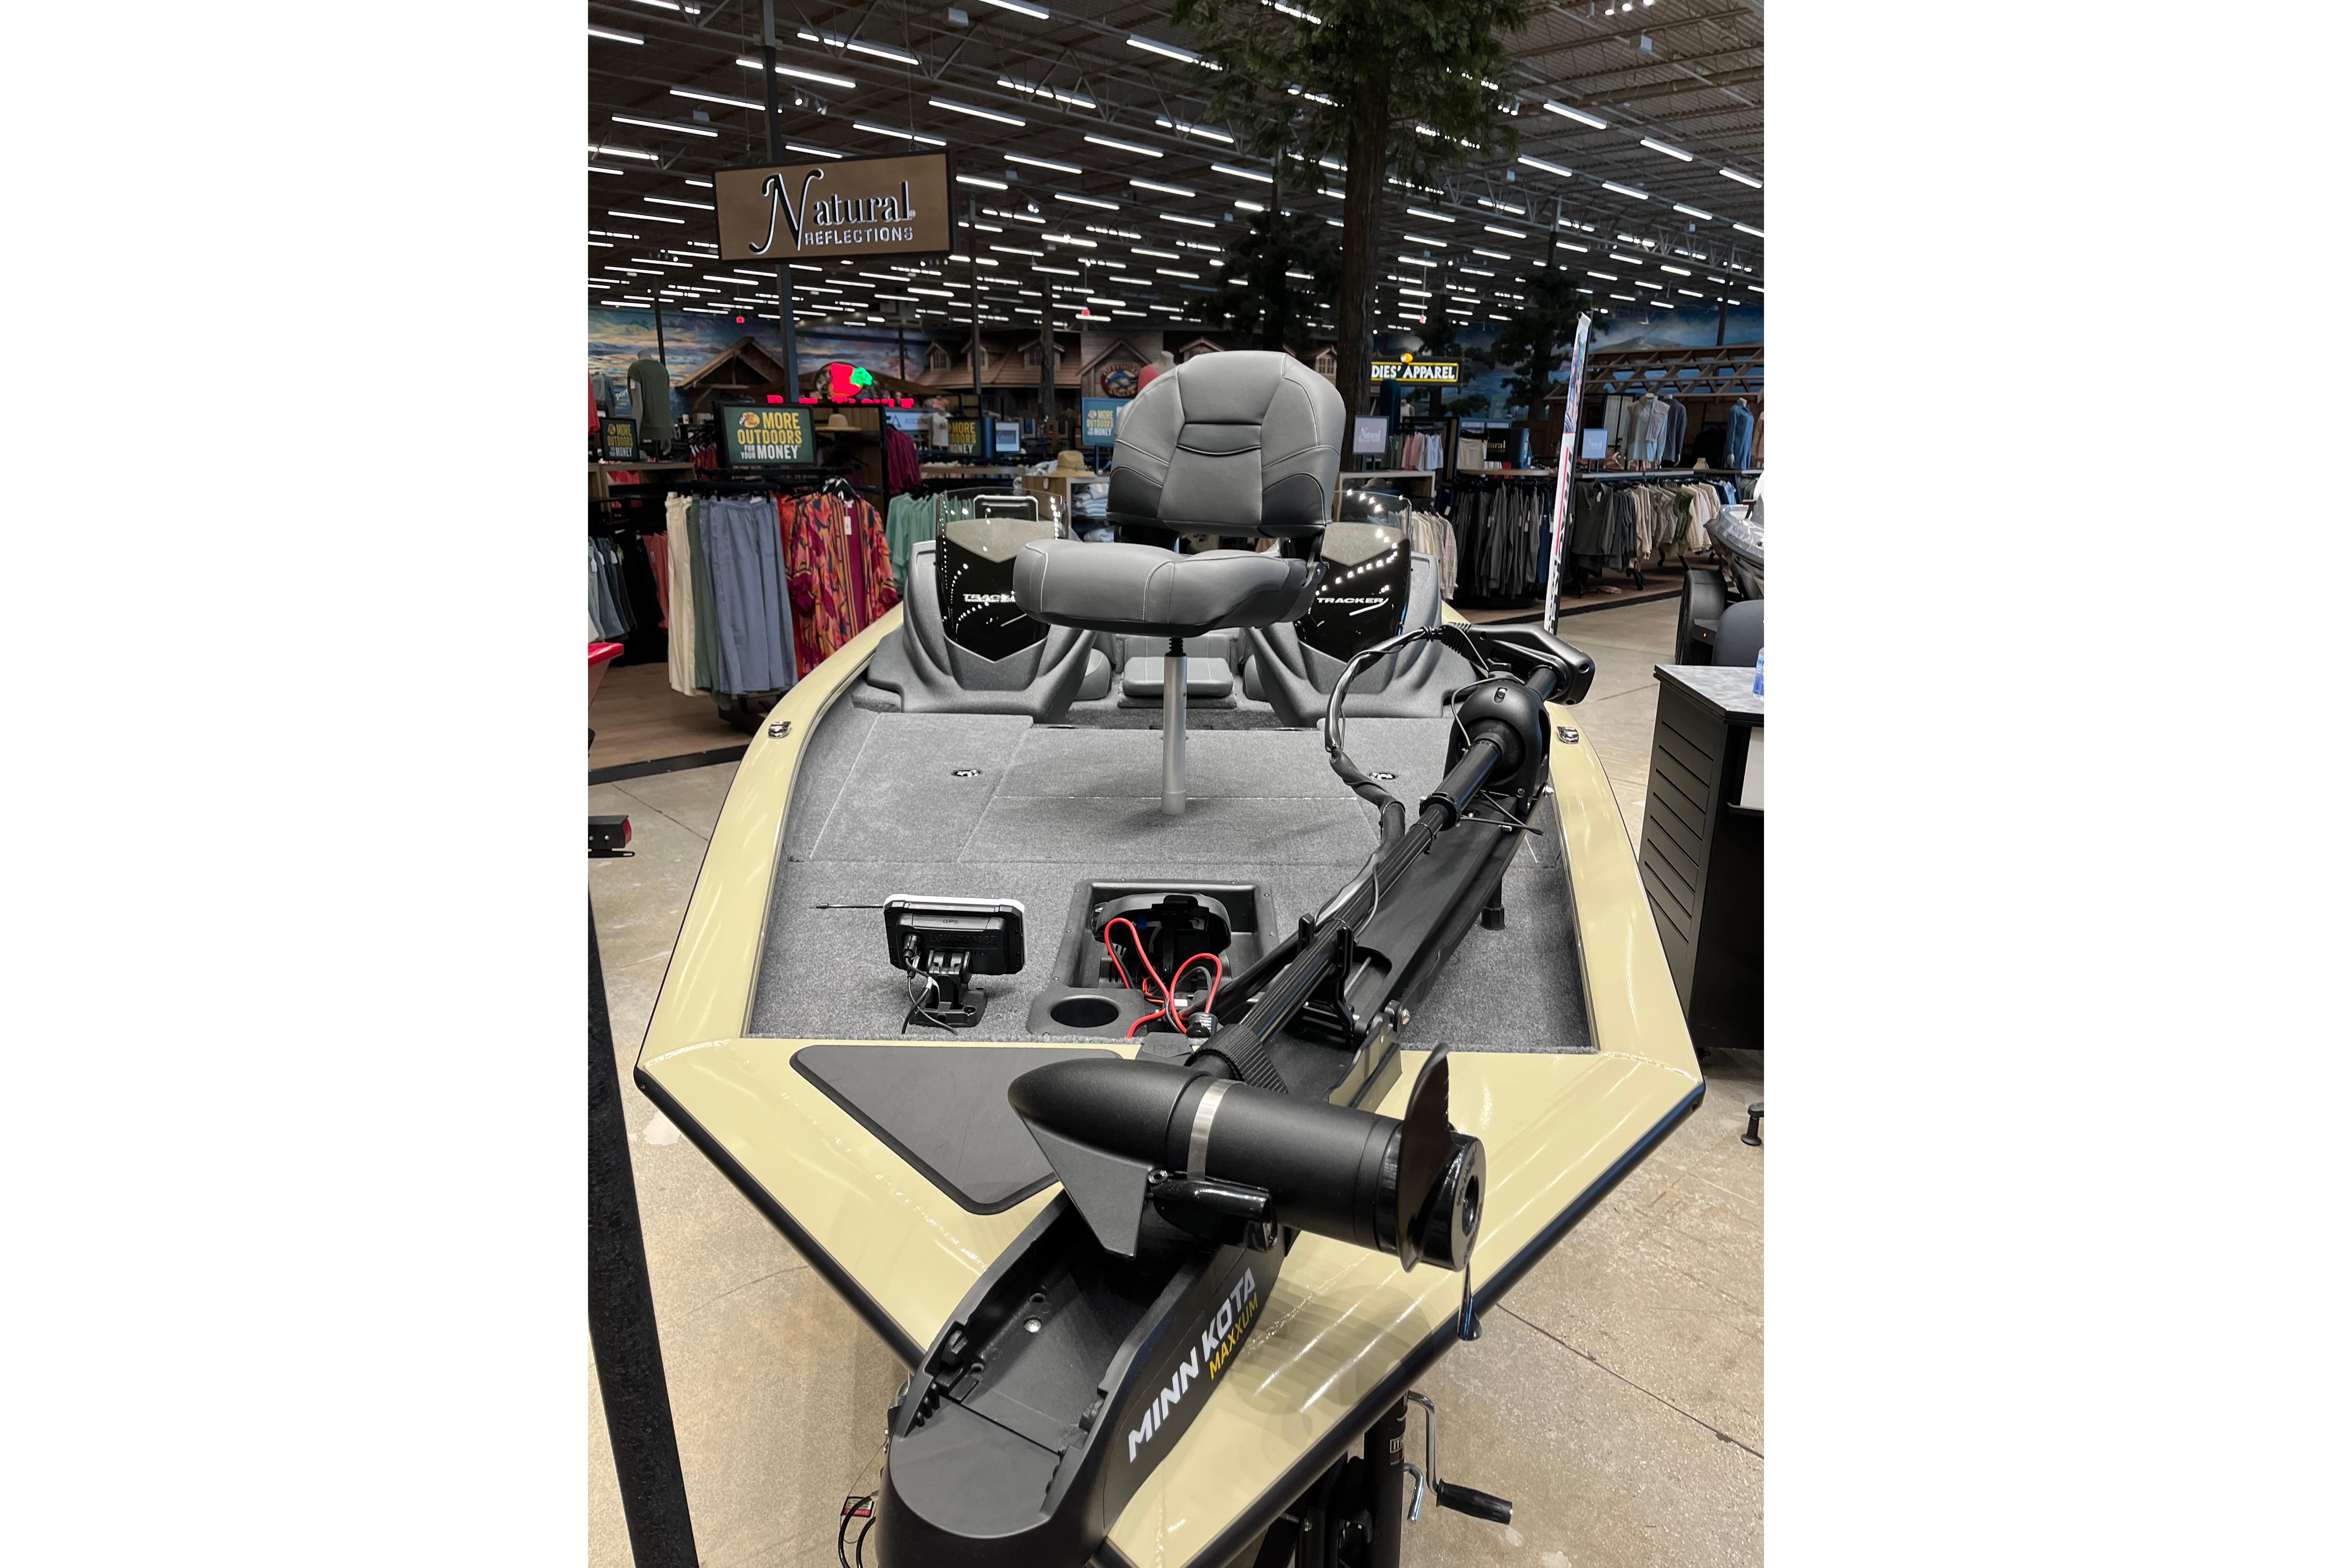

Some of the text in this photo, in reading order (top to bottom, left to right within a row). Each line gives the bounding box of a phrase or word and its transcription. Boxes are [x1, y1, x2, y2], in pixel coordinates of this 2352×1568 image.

[805, 227, 913, 245] REFLECTIONS
[1371, 365, 1455, 379] DIES' APPAREL
[762, 412, 801, 429] MORE
[952, 422, 976, 434] MORE
[737, 429, 802, 444] OUTDOORS
[948, 434, 976, 444] DOORS
[757, 444, 797, 459] MONEY
[1209, 1292, 1258, 1380] MAXXUM
[1128, 1267, 1256, 1463] MINN KOTA
